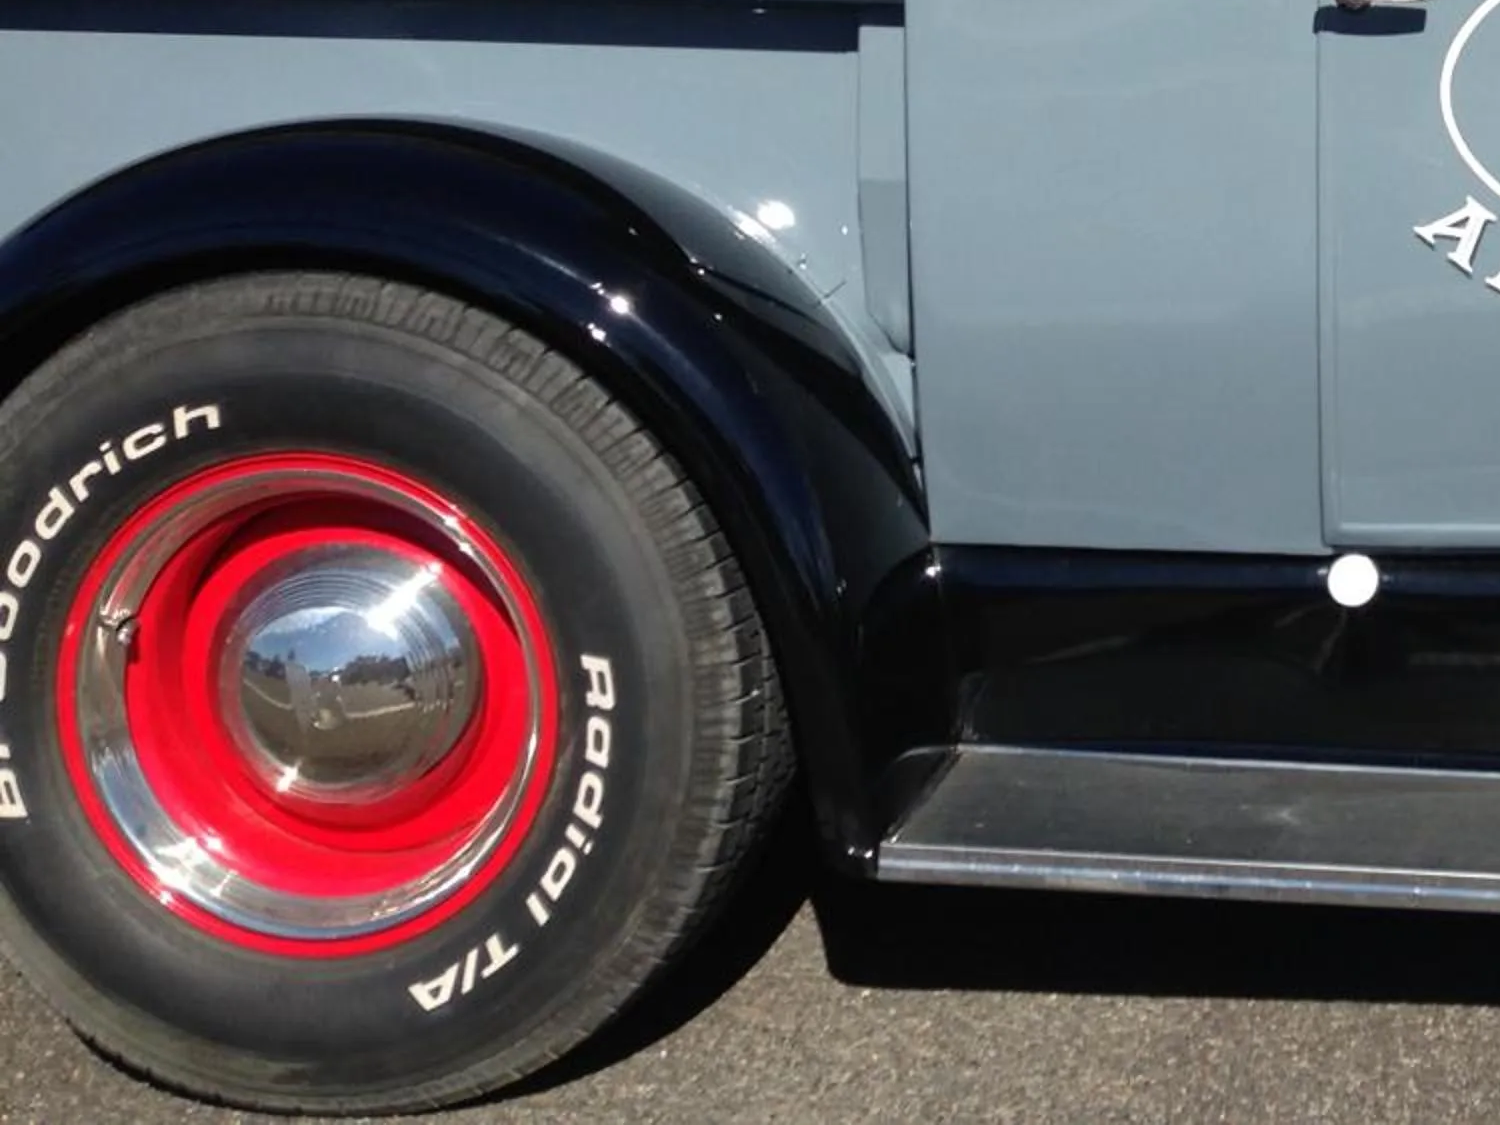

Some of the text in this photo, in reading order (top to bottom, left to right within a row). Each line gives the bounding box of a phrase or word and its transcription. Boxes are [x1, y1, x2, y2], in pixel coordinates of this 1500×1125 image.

[0, 403, 221, 821] Boodrich
[407, 653, 616, 1012] Radial T/A
